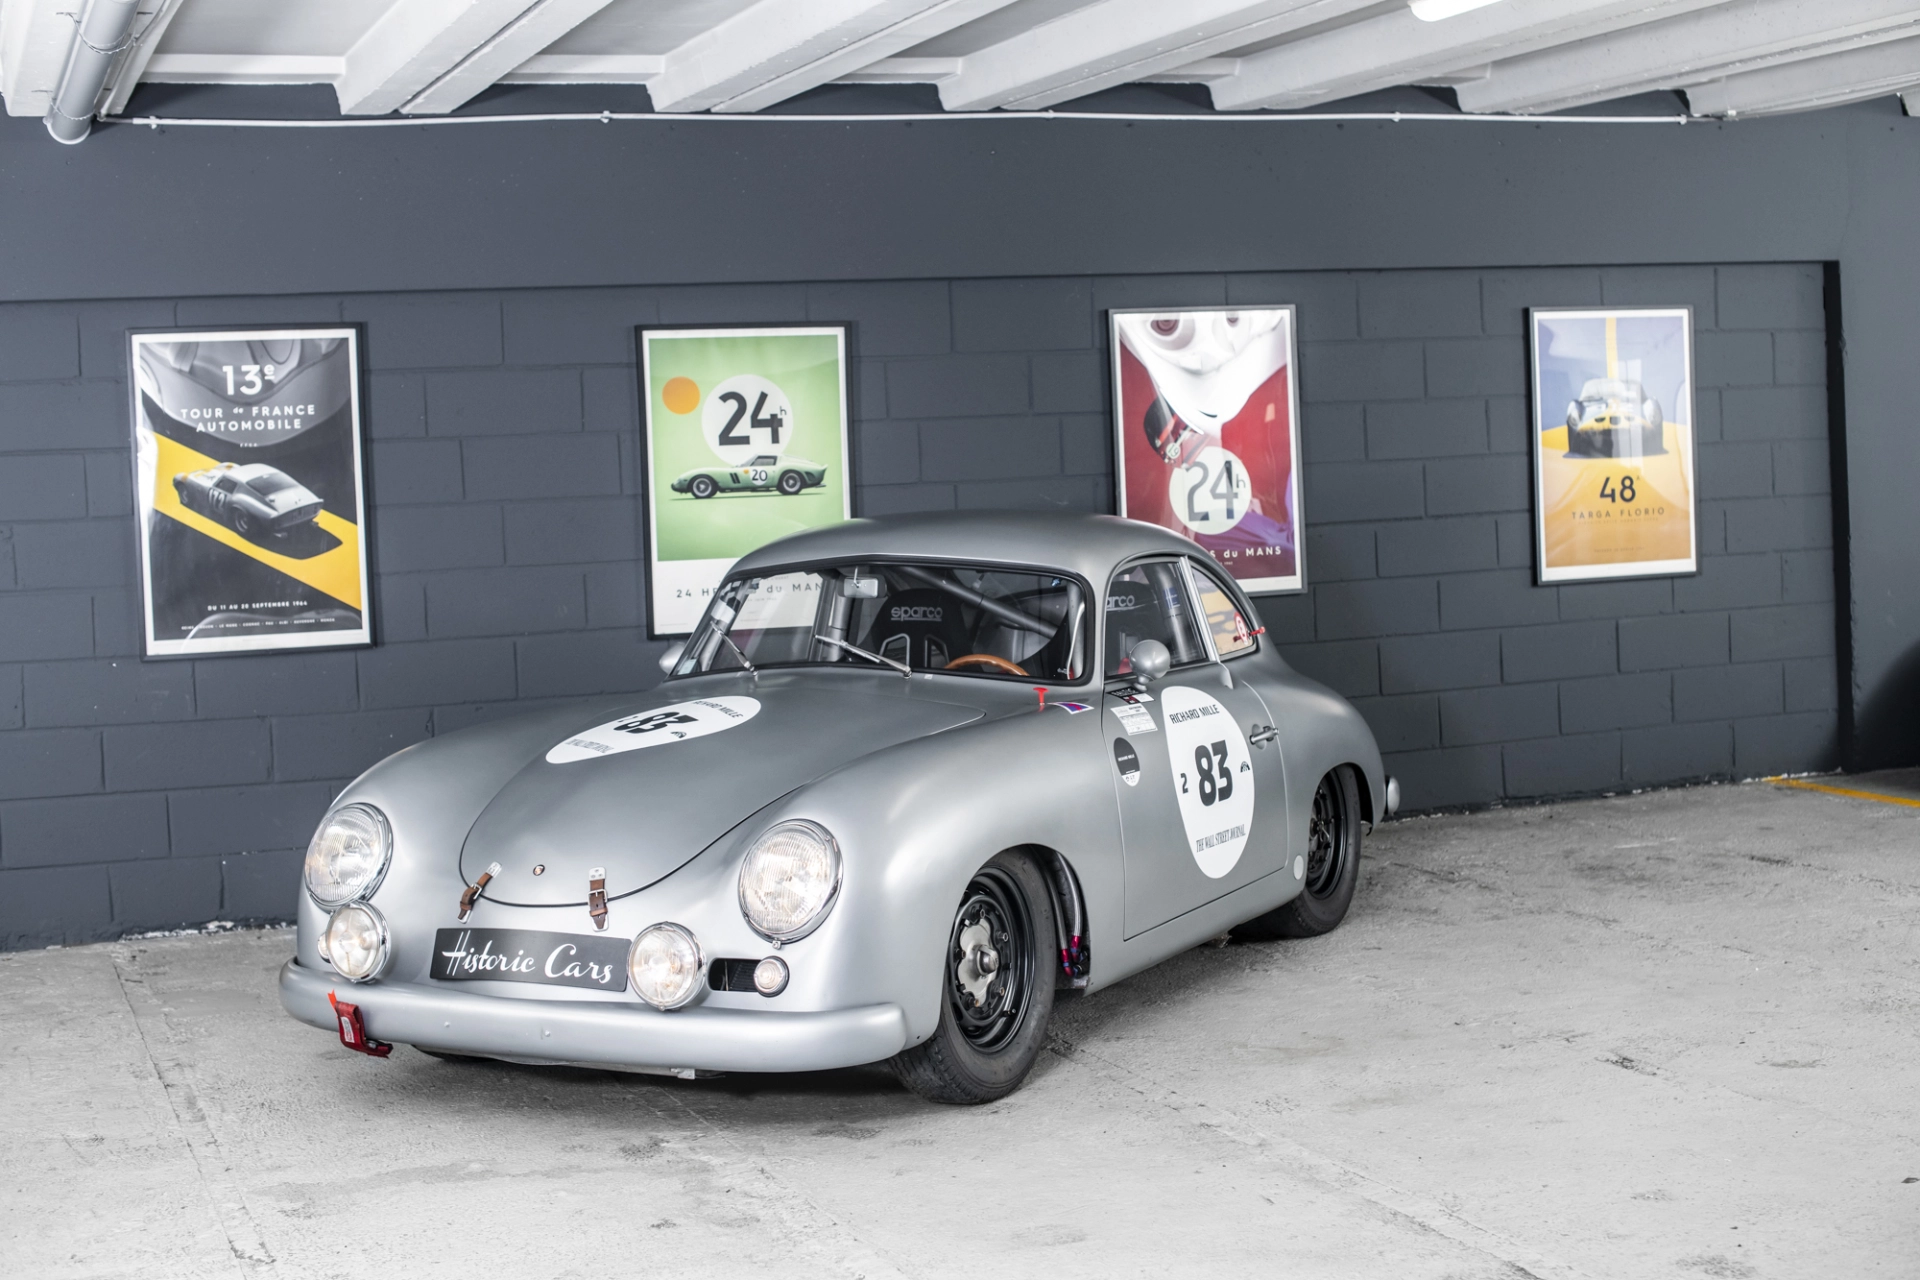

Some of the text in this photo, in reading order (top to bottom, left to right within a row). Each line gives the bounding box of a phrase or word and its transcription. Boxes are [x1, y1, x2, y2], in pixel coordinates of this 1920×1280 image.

[180, 404, 316, 420] TOUR de FRANCE
[195, 418, 302, 433] AUTOMOBILE
[751, 469, 768, 482] 20
[1571, 506, 1665, 520] TARGA FLORIO
[1223, 549, 1238, 559] du
[1245, 545, 1282, 558] MANS
[676, 588, 692, 599] 24
[766, 584, 783, 594] du
[792, 582, 823, 593] MAN
[891, 606, 943, 621] sparco
[1169, 704, 1220, 724] RICHARD MILLE
[613, 711, 699, 734] 83
[1194, 739, 1233, 807] 83
[1214, 828, 1230, 847] STREET
[442, 929, 614, 984] Historic Cars
